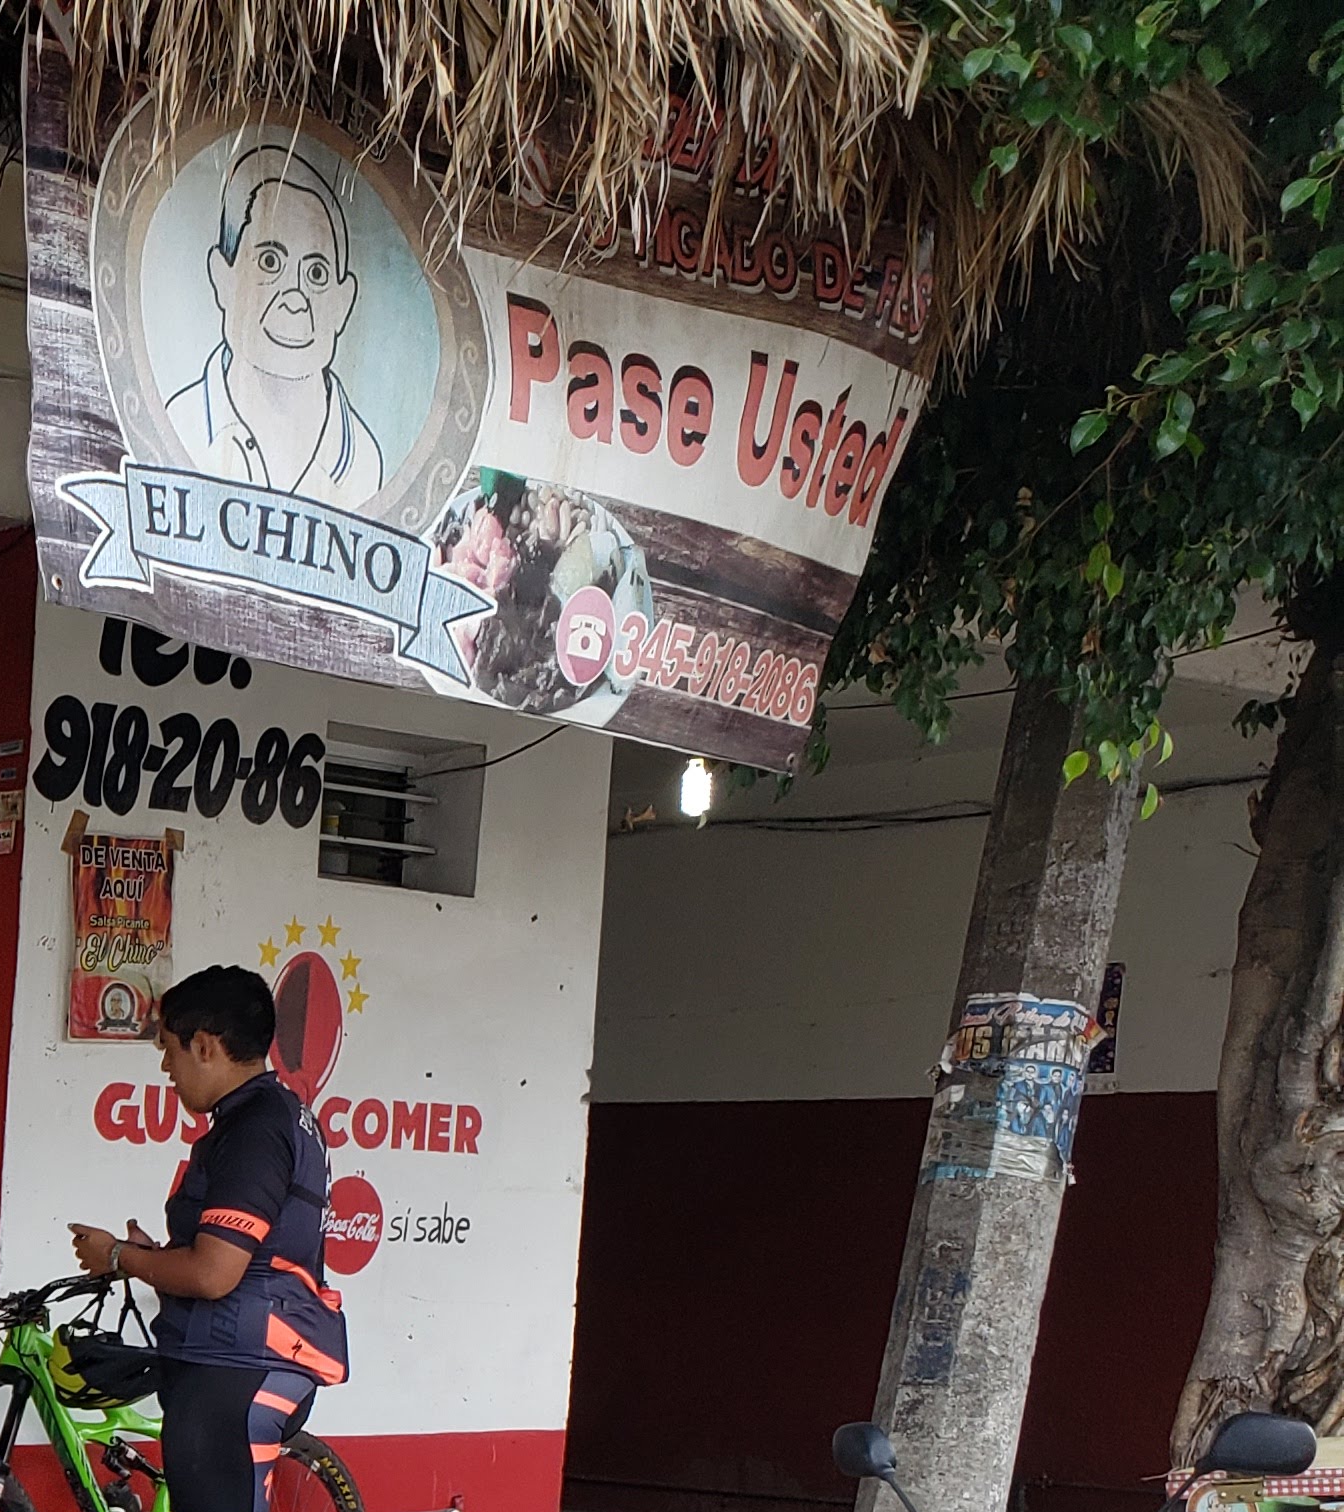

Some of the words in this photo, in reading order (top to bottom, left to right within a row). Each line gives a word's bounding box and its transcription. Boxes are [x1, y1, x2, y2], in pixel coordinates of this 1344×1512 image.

[506, 292, 713, 467] Pase
[735, 352, 910, 528] Usted
[140, 482, 207, 543] EL
[218, 500, 404, 594] CHINO
[613, 610, 818, 727] 345-918-2086
[32, 694, 327, 829] 918-20-86
[81, 845, 106, 868] DE
[111, 847, 167, 872] VENTA
[100, 875, 144, 901] AQUÍ
[89, 914, 114, 928] Salsa
[117, 916, 150, 929] Picante
[320, 1096, 483, 1155] COMER
[319, 1456, 357, 1510] MAXXIS
